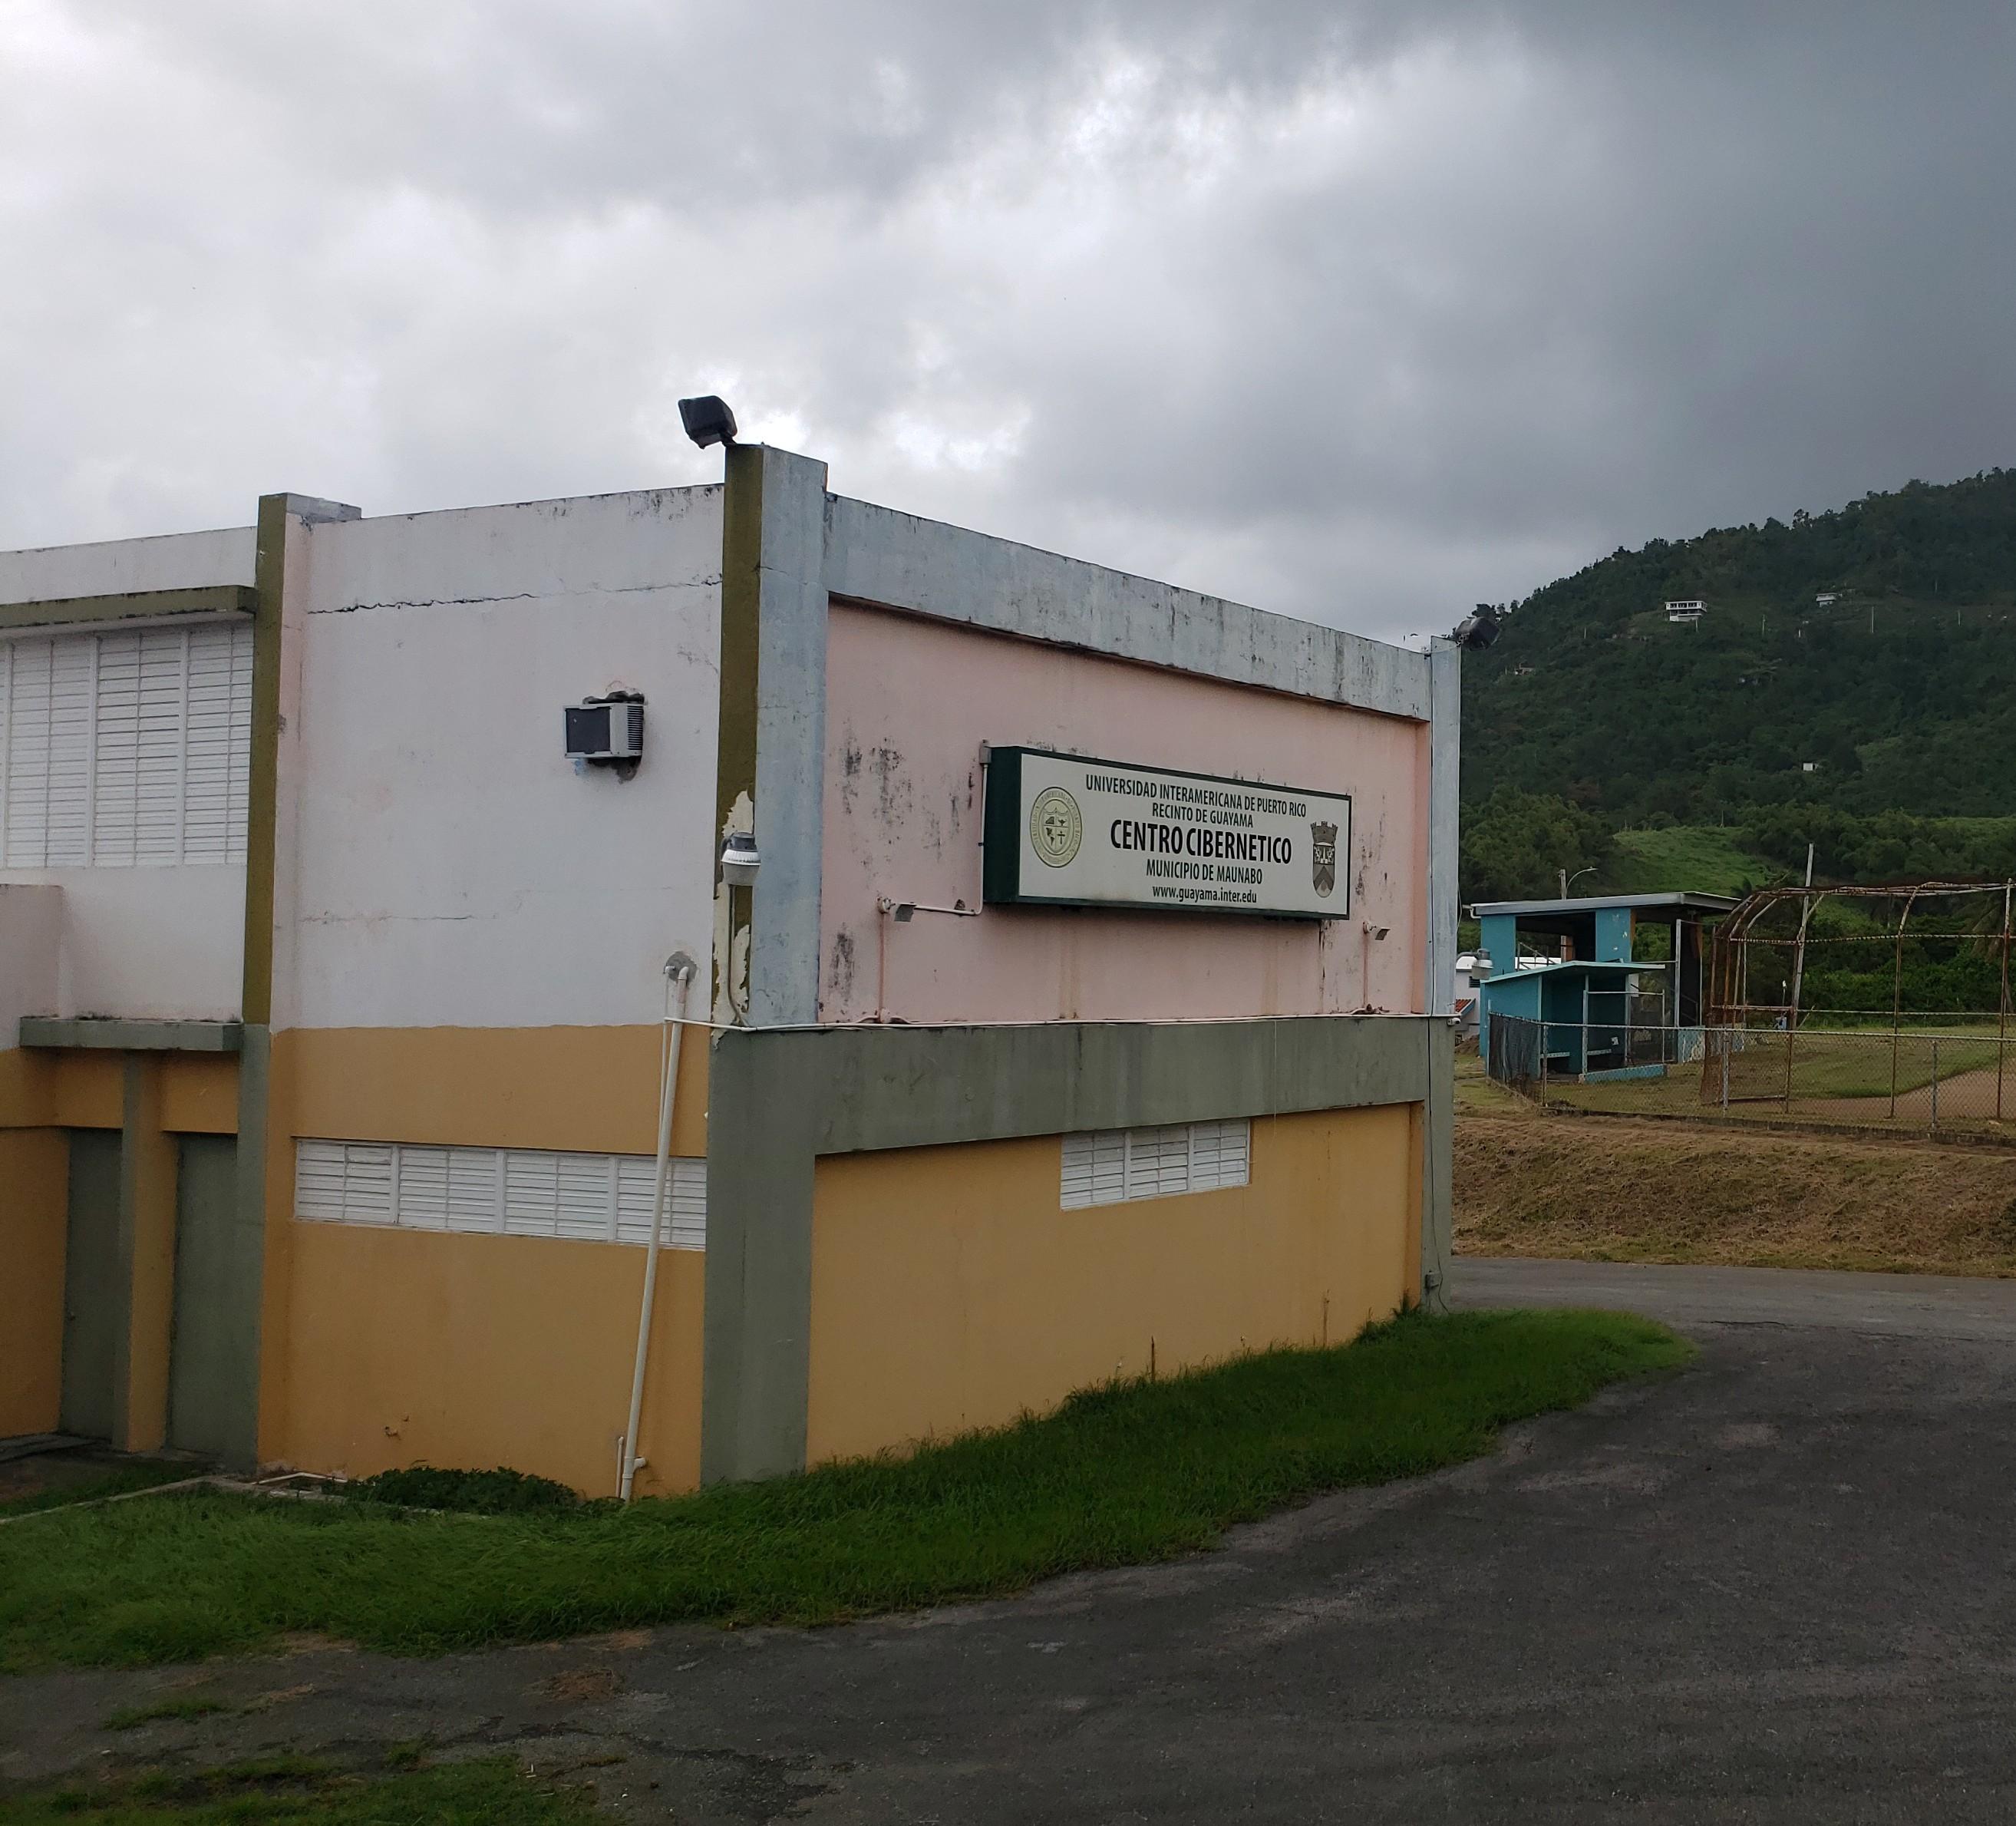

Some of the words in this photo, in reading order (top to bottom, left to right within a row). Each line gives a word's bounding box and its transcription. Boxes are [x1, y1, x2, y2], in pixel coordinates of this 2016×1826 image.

[1086, 774, 1157, 798] UNIVERSIDAD
[1160, 783, 1242, 811] INTERAMERICANA
[1244, 795, 1255, 812] DE
[1256, 797, 1288, 815] PUERTO
[1288, 801, 1307, 818] RICO
[1152, 802, 1193, 821] RECINTO
[1195, 807, 1208, 824] DE
[1209, 810, 1254, 828] GUAYAMA
[1110, 819, 1183, 855] CENTRO
[1186, 827, 1292, 864] CIBERNETICO
[1146, 858, 1200, 880] MUNICIPIO
[1202, 863, 1214, 881] DE
[1216, 865, 1263, 885] MAUNABO
[1152, 886, 1257, 903] www.guayama.inter.edu
